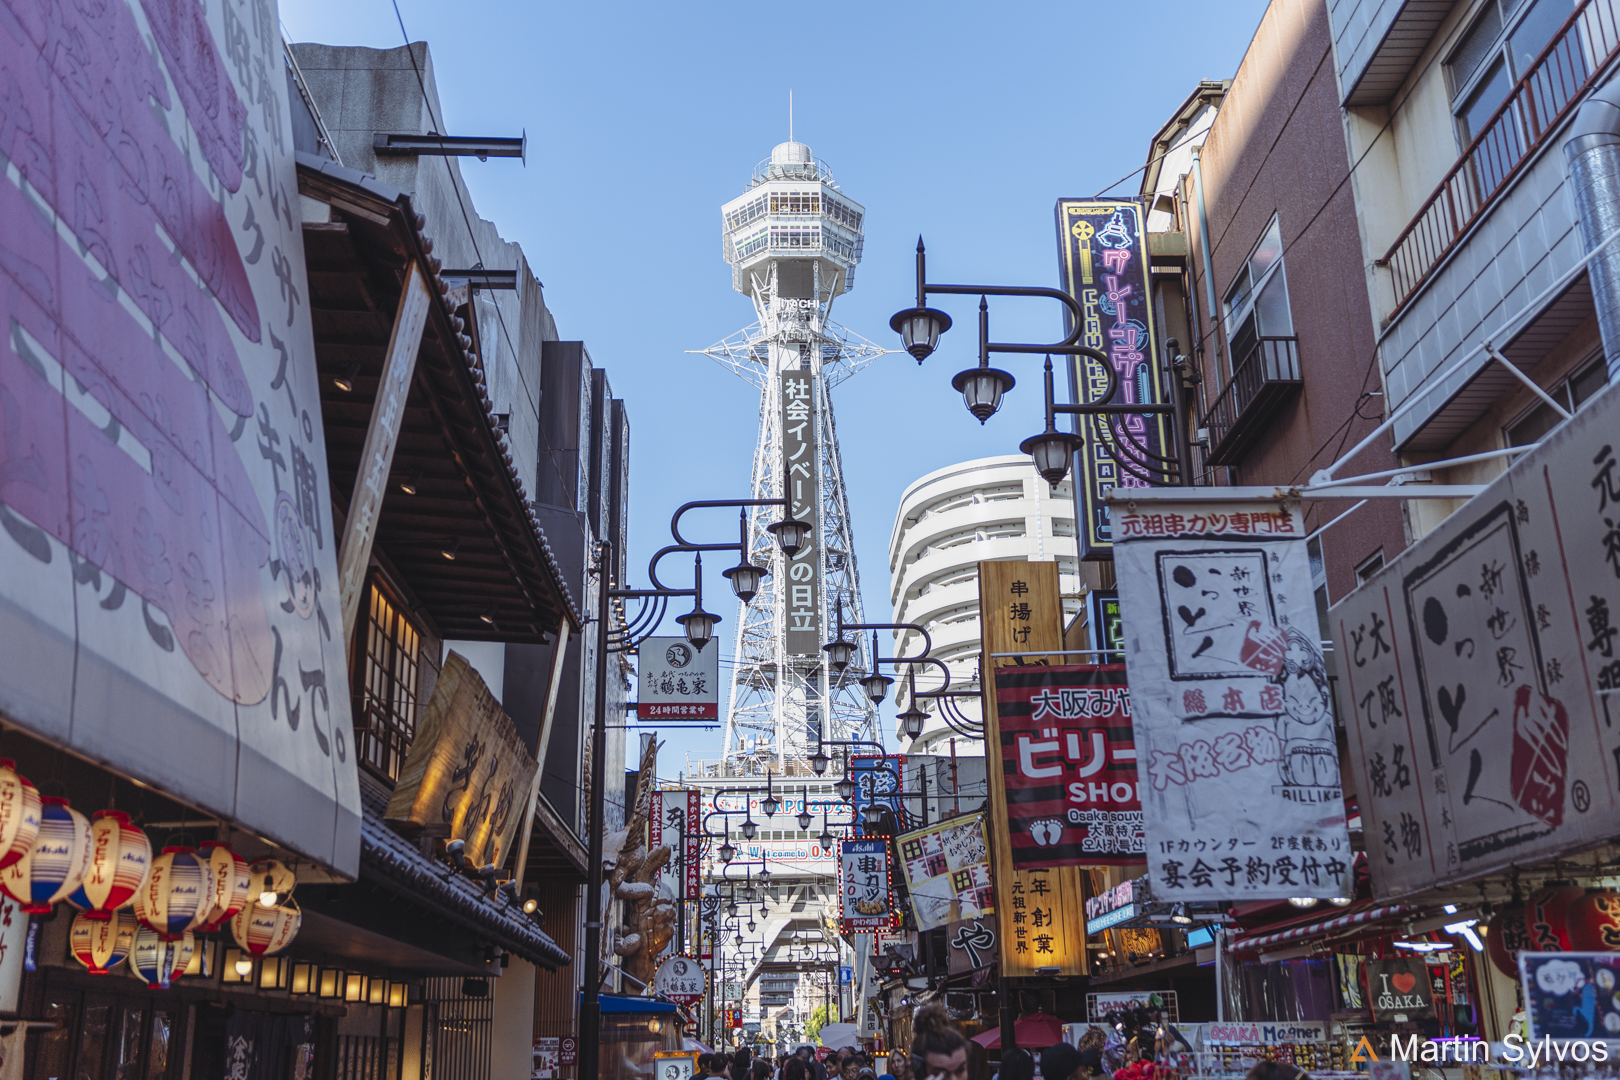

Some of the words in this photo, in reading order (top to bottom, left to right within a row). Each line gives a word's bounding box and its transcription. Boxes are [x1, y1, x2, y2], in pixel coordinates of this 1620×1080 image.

[785, 378, 816, 632] 社会イノベーシンの日立
[1121, 511, 1295, 536] 元祖串カツ専門店
[1010, 579, 1032, 643] 串揚げ
[1479, 559, 1525, 688] 新世界
[660, 677, 708, 695] 鶴亀家
[1586, 594, 1620, 796] 専門
[650, 705, 705, 715] 24時間営業中
[1182, 685, 1284, 714] 総本店
[1350, 622, 1397, 864] どて焼き
[1368, 612, 1422, 860] 大阪名物
[1069, 782, 1142, 803] SHO
[1069, 810, 1108, 823] Osaka
[35, 844, 69, 855] Asahi
[91, 828, 111, 884] アサヒビール
[852, 843, 874, 852] Asahi
[1083, 838, 1146, 853] 오사카특산
[1160, 837, 1257, 854] 1Fカウンター
[1271, 836, 1341, 852] 2F座敷あり
[857, 855, 880, 901] 串カツ
[1160, 855, 1347, 890] 宴会予約受付中
[149, 866, 163, 917] アサヒビール
[171, 885, 197, 895] Asahi
[252, 918, 275, 929] Asahi
[1379, 973, 1391, 996] I
[1210, 1025, 1259, 1042] OSAKA
[1263, 1025, 1322, 1042] Magnet
